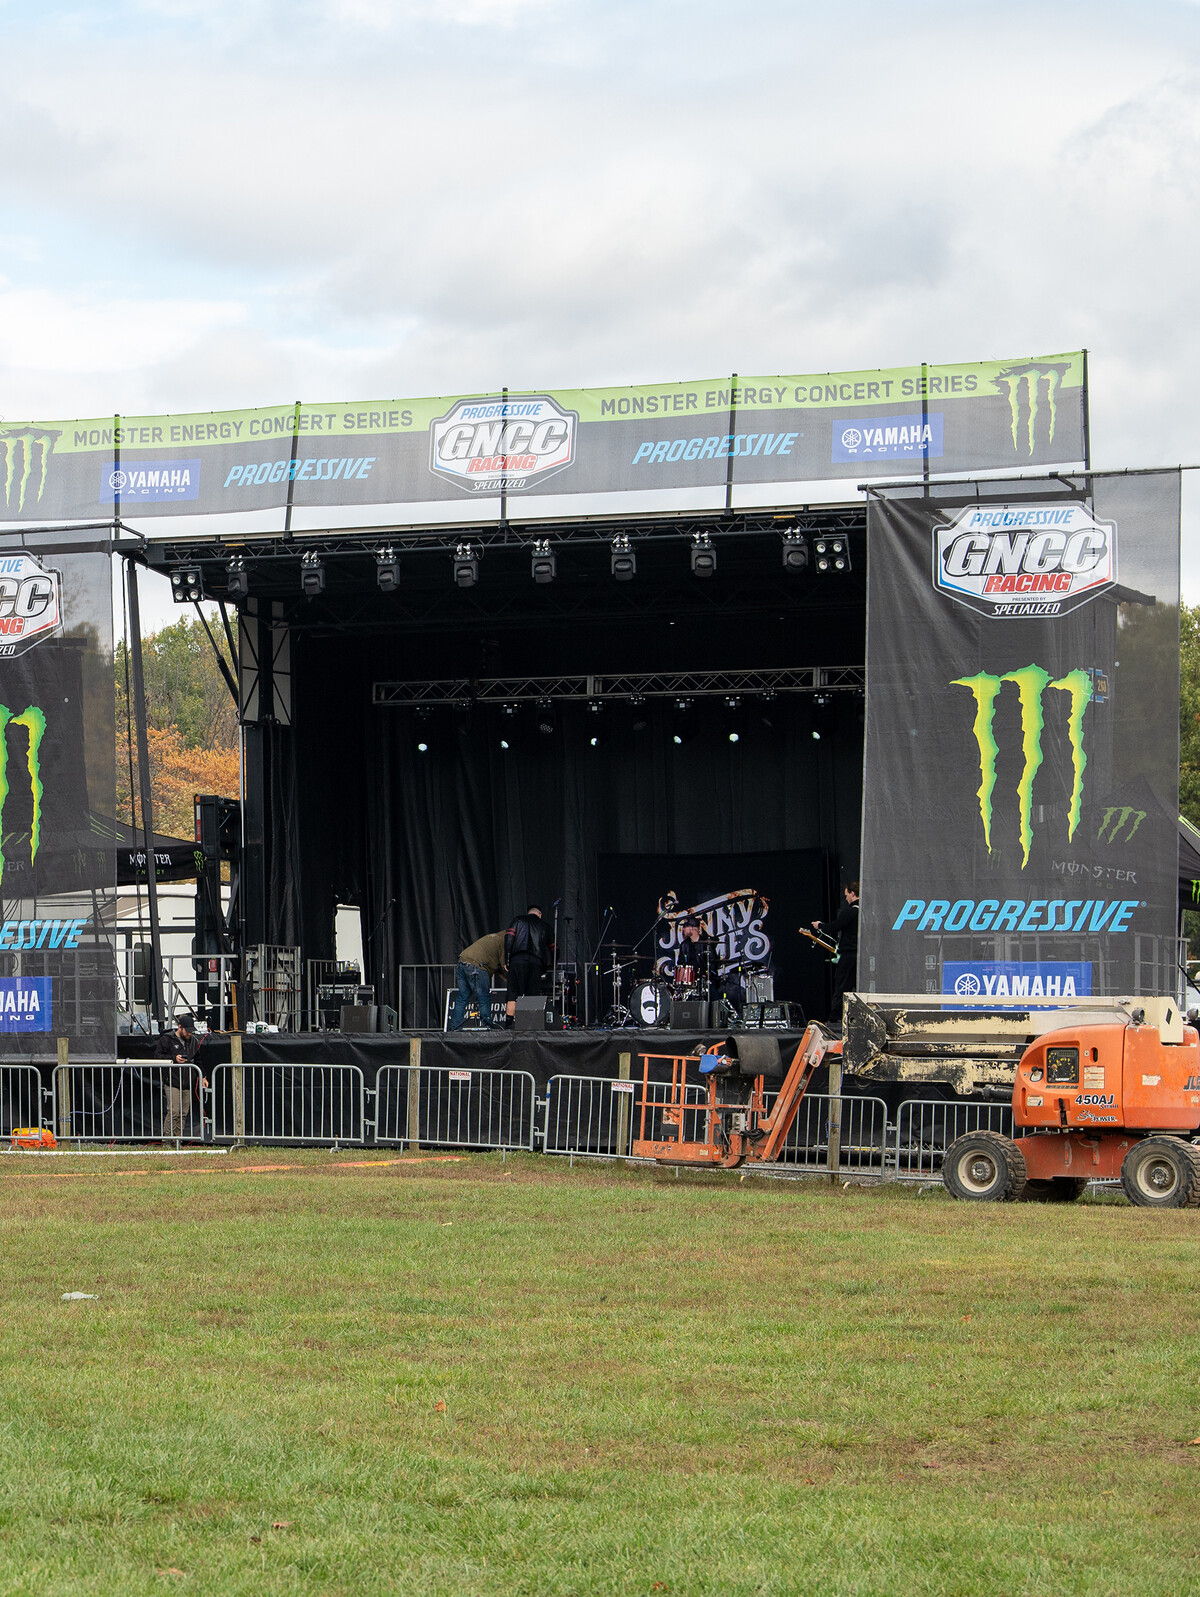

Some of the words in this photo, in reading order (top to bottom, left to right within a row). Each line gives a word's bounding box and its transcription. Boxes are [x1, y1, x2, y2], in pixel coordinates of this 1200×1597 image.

[601, 392, 700, 416] MONSTER
[705, 385, 786, 407] ENERGY
[794, 380, 896, 403] CONCERT
[901, 374, 978, 396] SERIES
[460, 403, 543, 420] PROGRESSIVE
[73, 424, 164, 448] MONSTER
[170, 420, 245, 443] ENERGY
[249, 413, 337, 436] CONCERT
[343, 409, 414, 431] SERIES
[439, 418, 569, 462] GNCC
[863, 422, 933, 447] YAMAHA
[632, 432, 799, 465] PROGRESSIVE
[848, 443, 928, 454] RACING
[223, 457, 377, 487] PROGRESSIVE
[466, 455, 538, 474] RACING
[114, 486, 186, 494] RACING
[128, 469, 191, 490] YAMAHA
[472, 478, 527, 491] SPECIALIZED
[969, 508, 1075, 527] PROGRESSIVE
[944, 528, 1107, 577] GNCC
[982, 572, 1074, 595] RACING
[991, 602, 1061, 616] SPECIALIZED
[891, 899, 1140, 933] PROGRESSIVE
[981, 974, 1077, 997] YAMAHA
[1075, 1094, 1115, 1106] 450AJ
